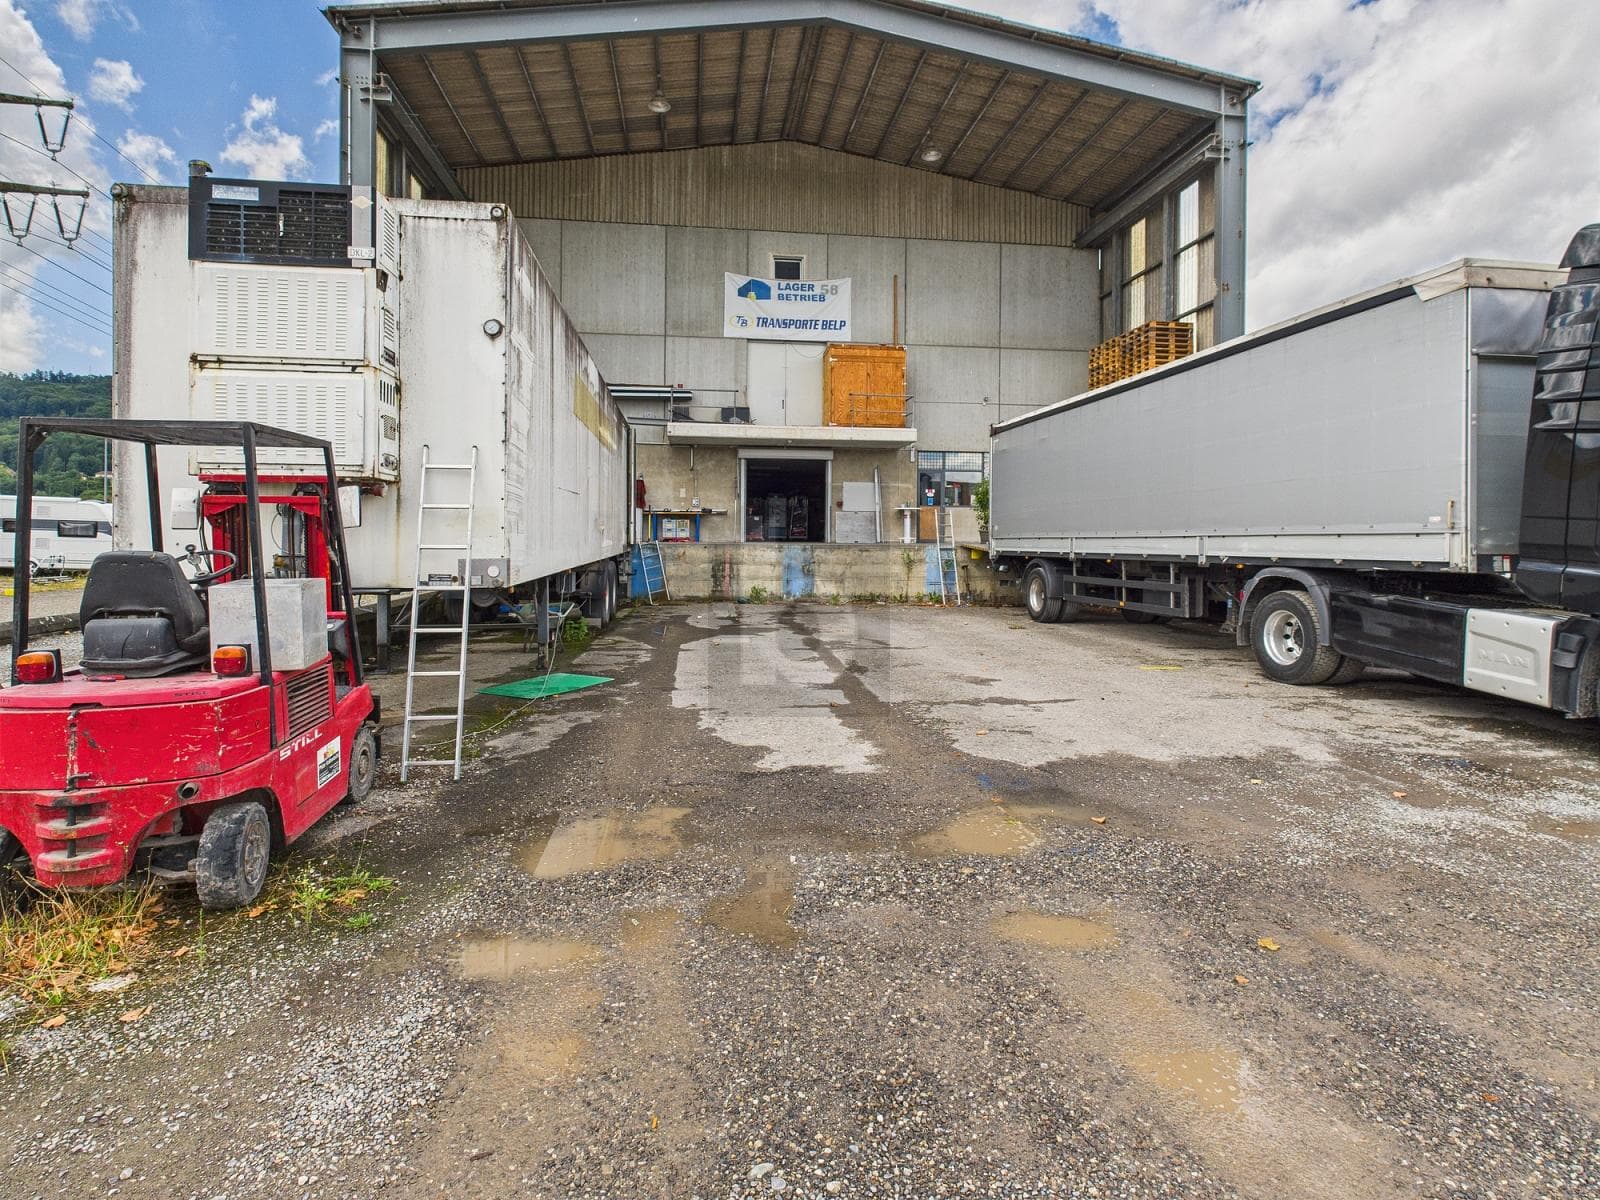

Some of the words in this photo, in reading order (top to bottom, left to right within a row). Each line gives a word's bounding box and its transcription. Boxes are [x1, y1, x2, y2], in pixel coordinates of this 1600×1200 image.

[777, 282, 815, 292] LAGER
[777, 293, 826, 302] BETRIEB
[756, 316, 819, 330] TRANSPORTE
[821, 319, 846, 331] BELP
[1479, 648, 1529, 669] MAN
[279, 728, 323, 762] STILL
